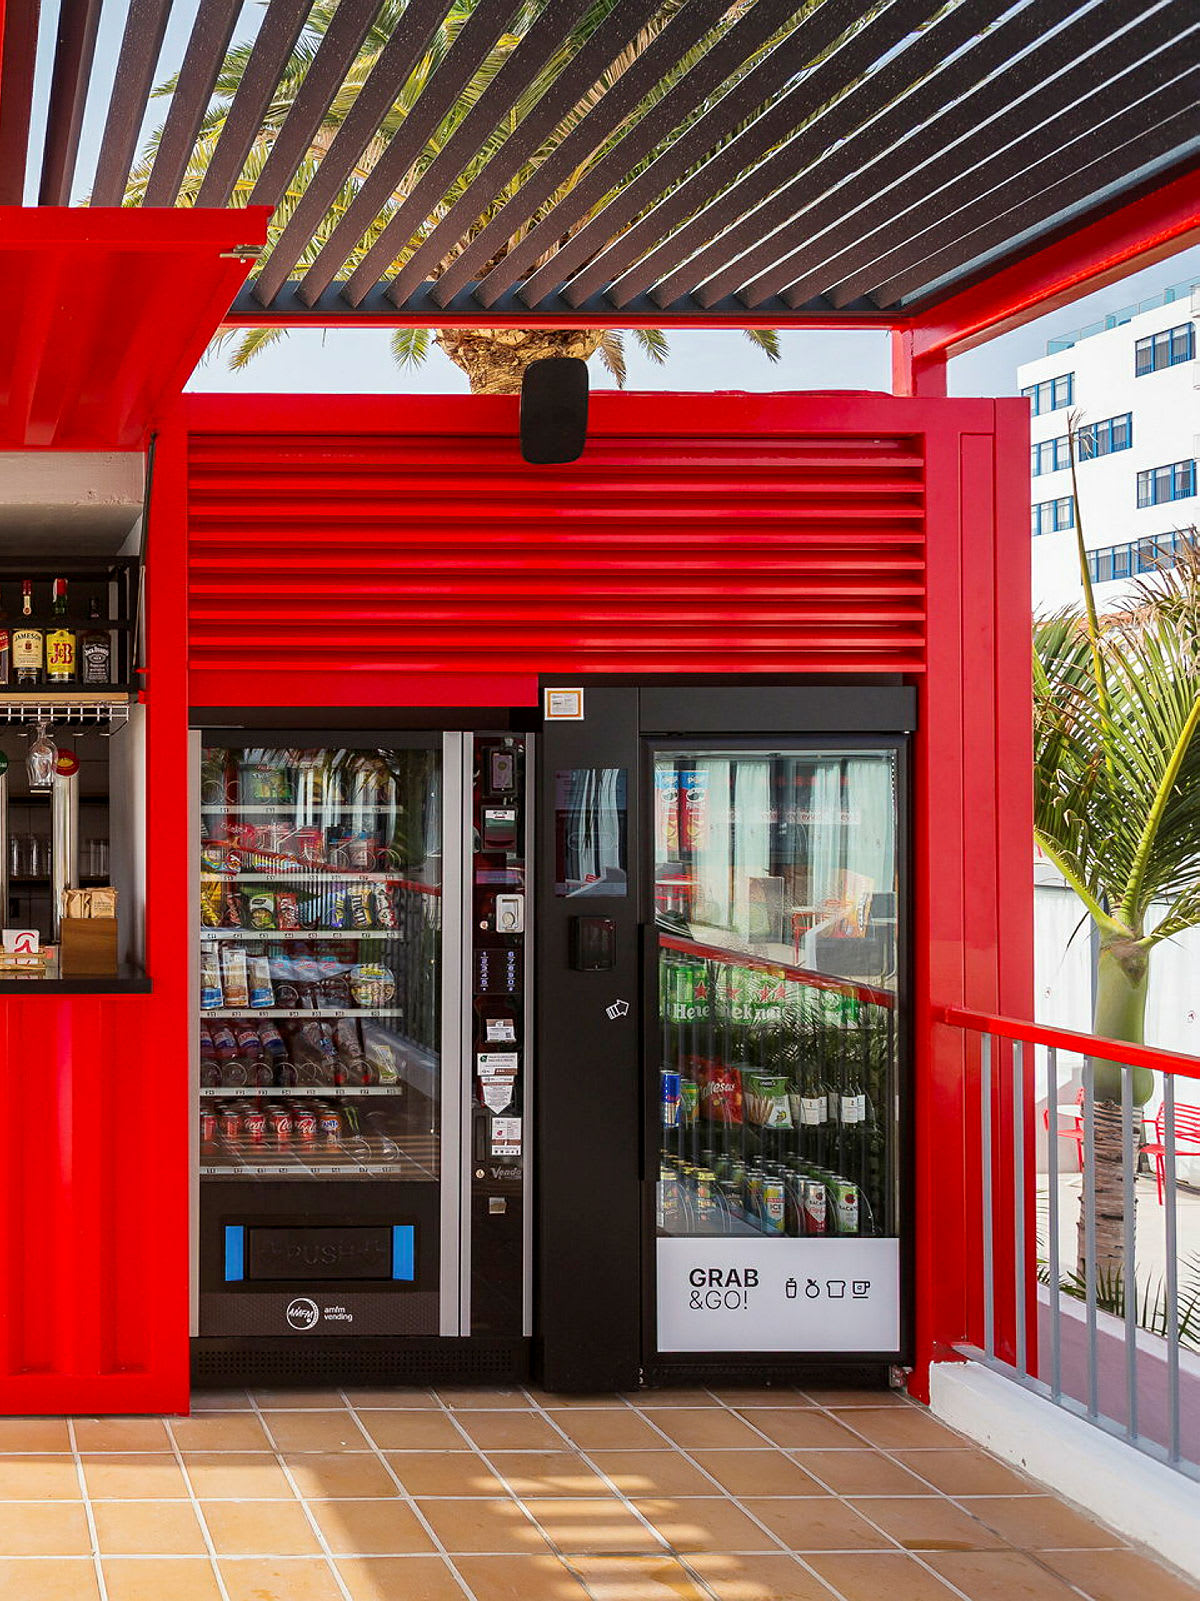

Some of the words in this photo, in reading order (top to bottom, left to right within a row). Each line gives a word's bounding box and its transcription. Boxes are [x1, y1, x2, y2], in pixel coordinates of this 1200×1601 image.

[15, 630, 41, 641] JAMESON
[689, 1269, 760, 1288] GRAB
[689, 1290, 749, 1310] &GO!
[324, 1306, 346, 1314] amfm
[324, 1313, 353, 1323] vending
